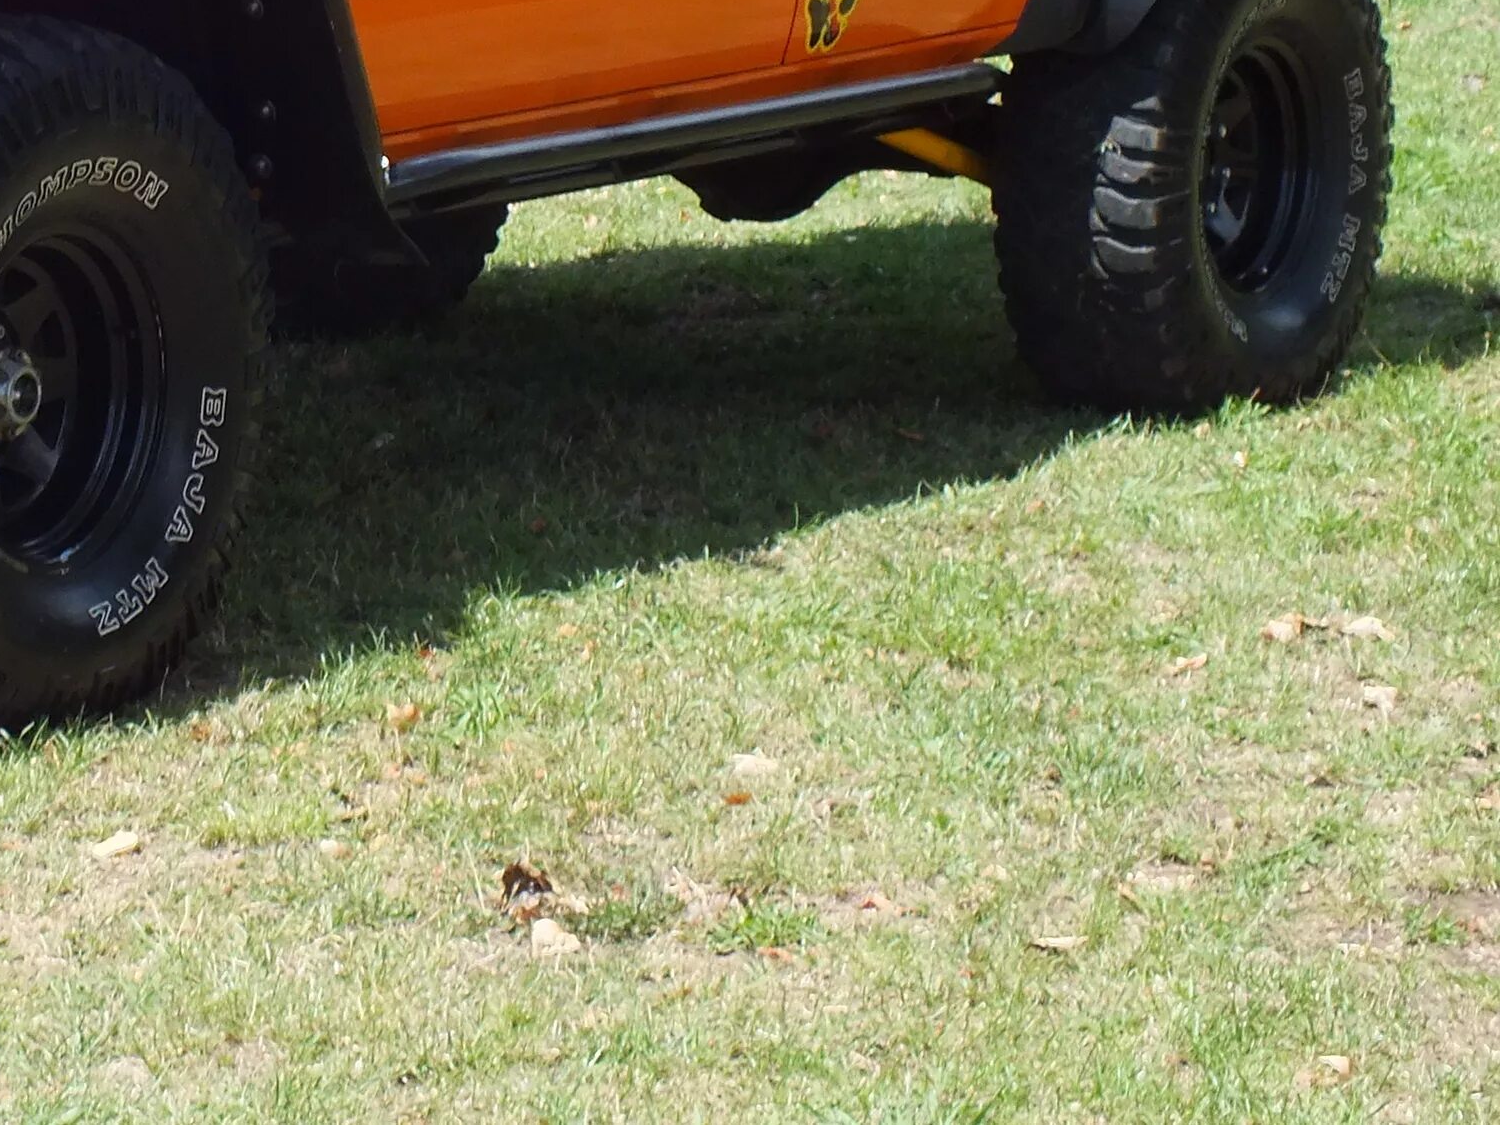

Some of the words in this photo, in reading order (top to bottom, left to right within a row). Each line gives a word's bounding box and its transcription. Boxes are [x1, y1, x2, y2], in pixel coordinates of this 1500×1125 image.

[1342, 67, 1367, 195] BAJA
[166, 386, 227, 545] BAJA
[88, 557, 169, 636] MTZ
